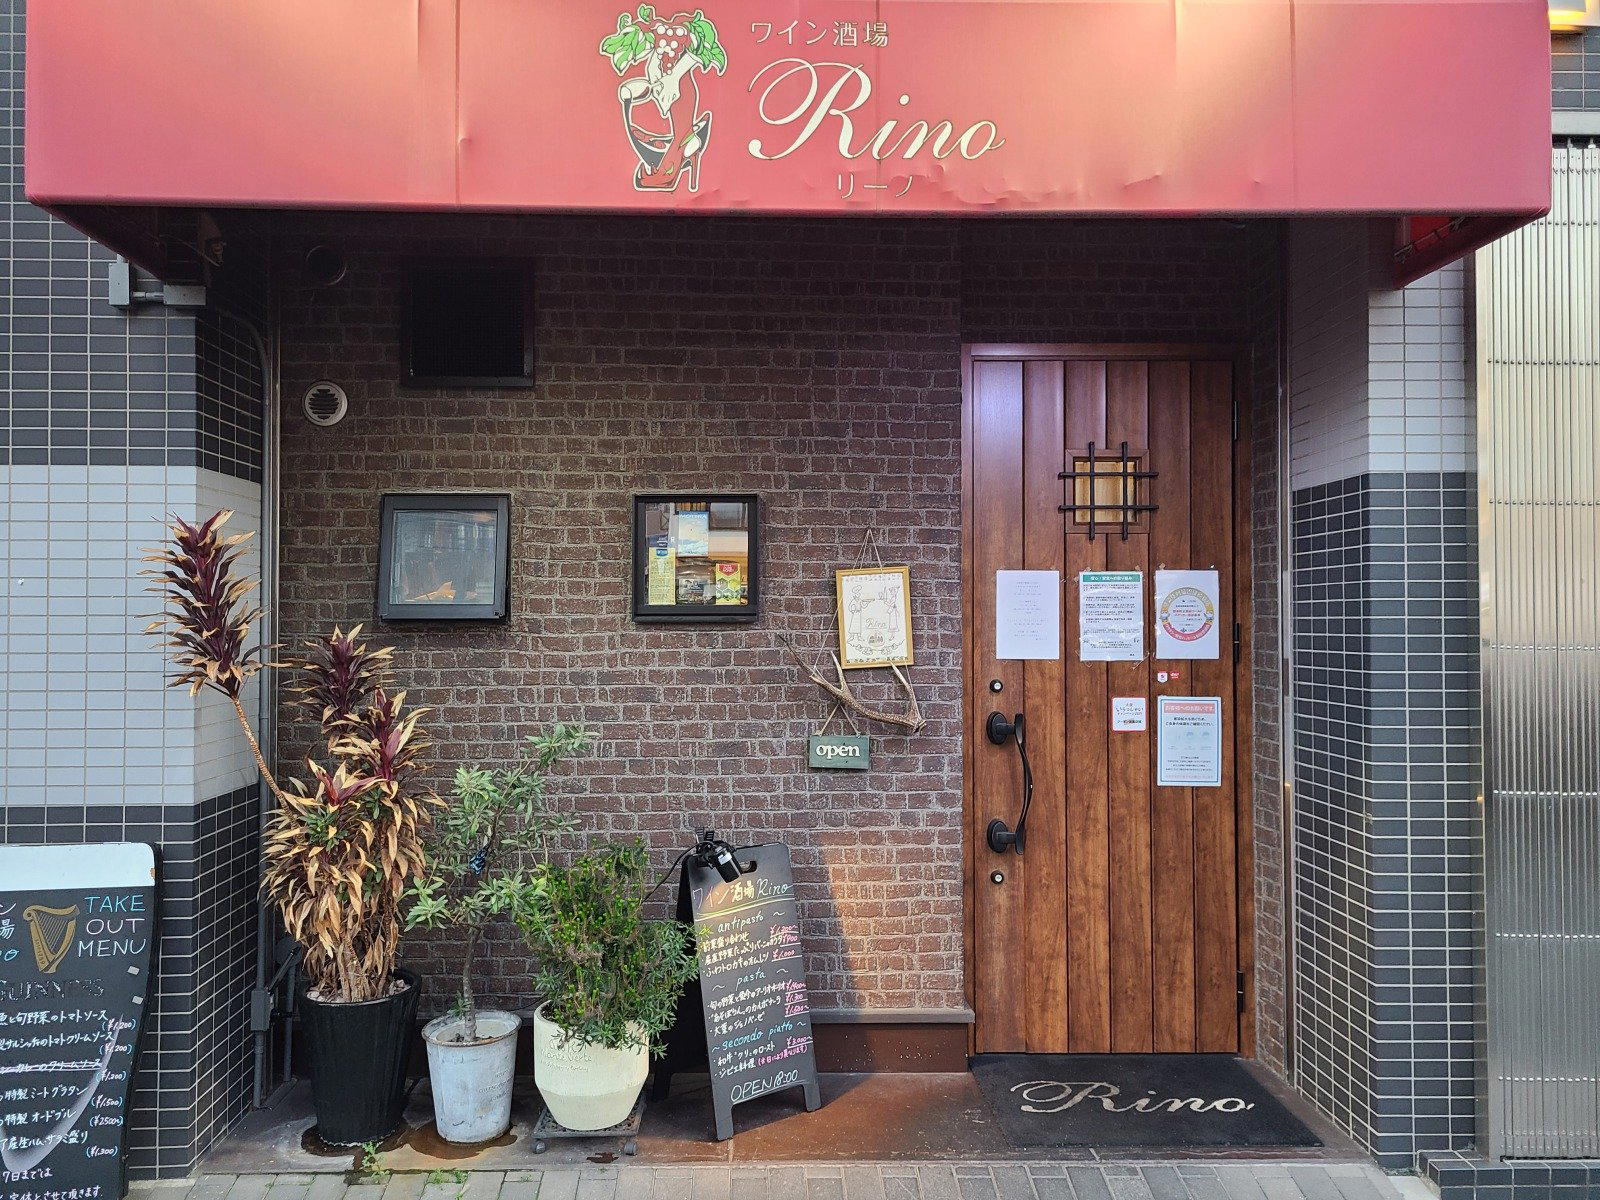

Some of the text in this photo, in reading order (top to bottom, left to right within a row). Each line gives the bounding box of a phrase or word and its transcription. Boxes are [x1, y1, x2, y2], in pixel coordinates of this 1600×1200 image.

[750, 20, 890, 48] ワイン酒場
[747, 58, 1006, 161] Rino
[837, 172, 914, 199] リーノ
[816, 744, 860, 760] open
[85, 894, 146, 914] TAKE
[692, 878, 794, 910] ワイン酒場 Rino
[86, 918, 146, 935] OUT
[718, 910, 764, 932] antipasto
[78, 938, 147, 958] MENU
[735, 966, 767, 991] pasta
[722, 1020, 794, 1051] secondo piatto
[730, 1076, 773, 1103] OPEN
[1010, 1080, 1255, 1113] Rino
